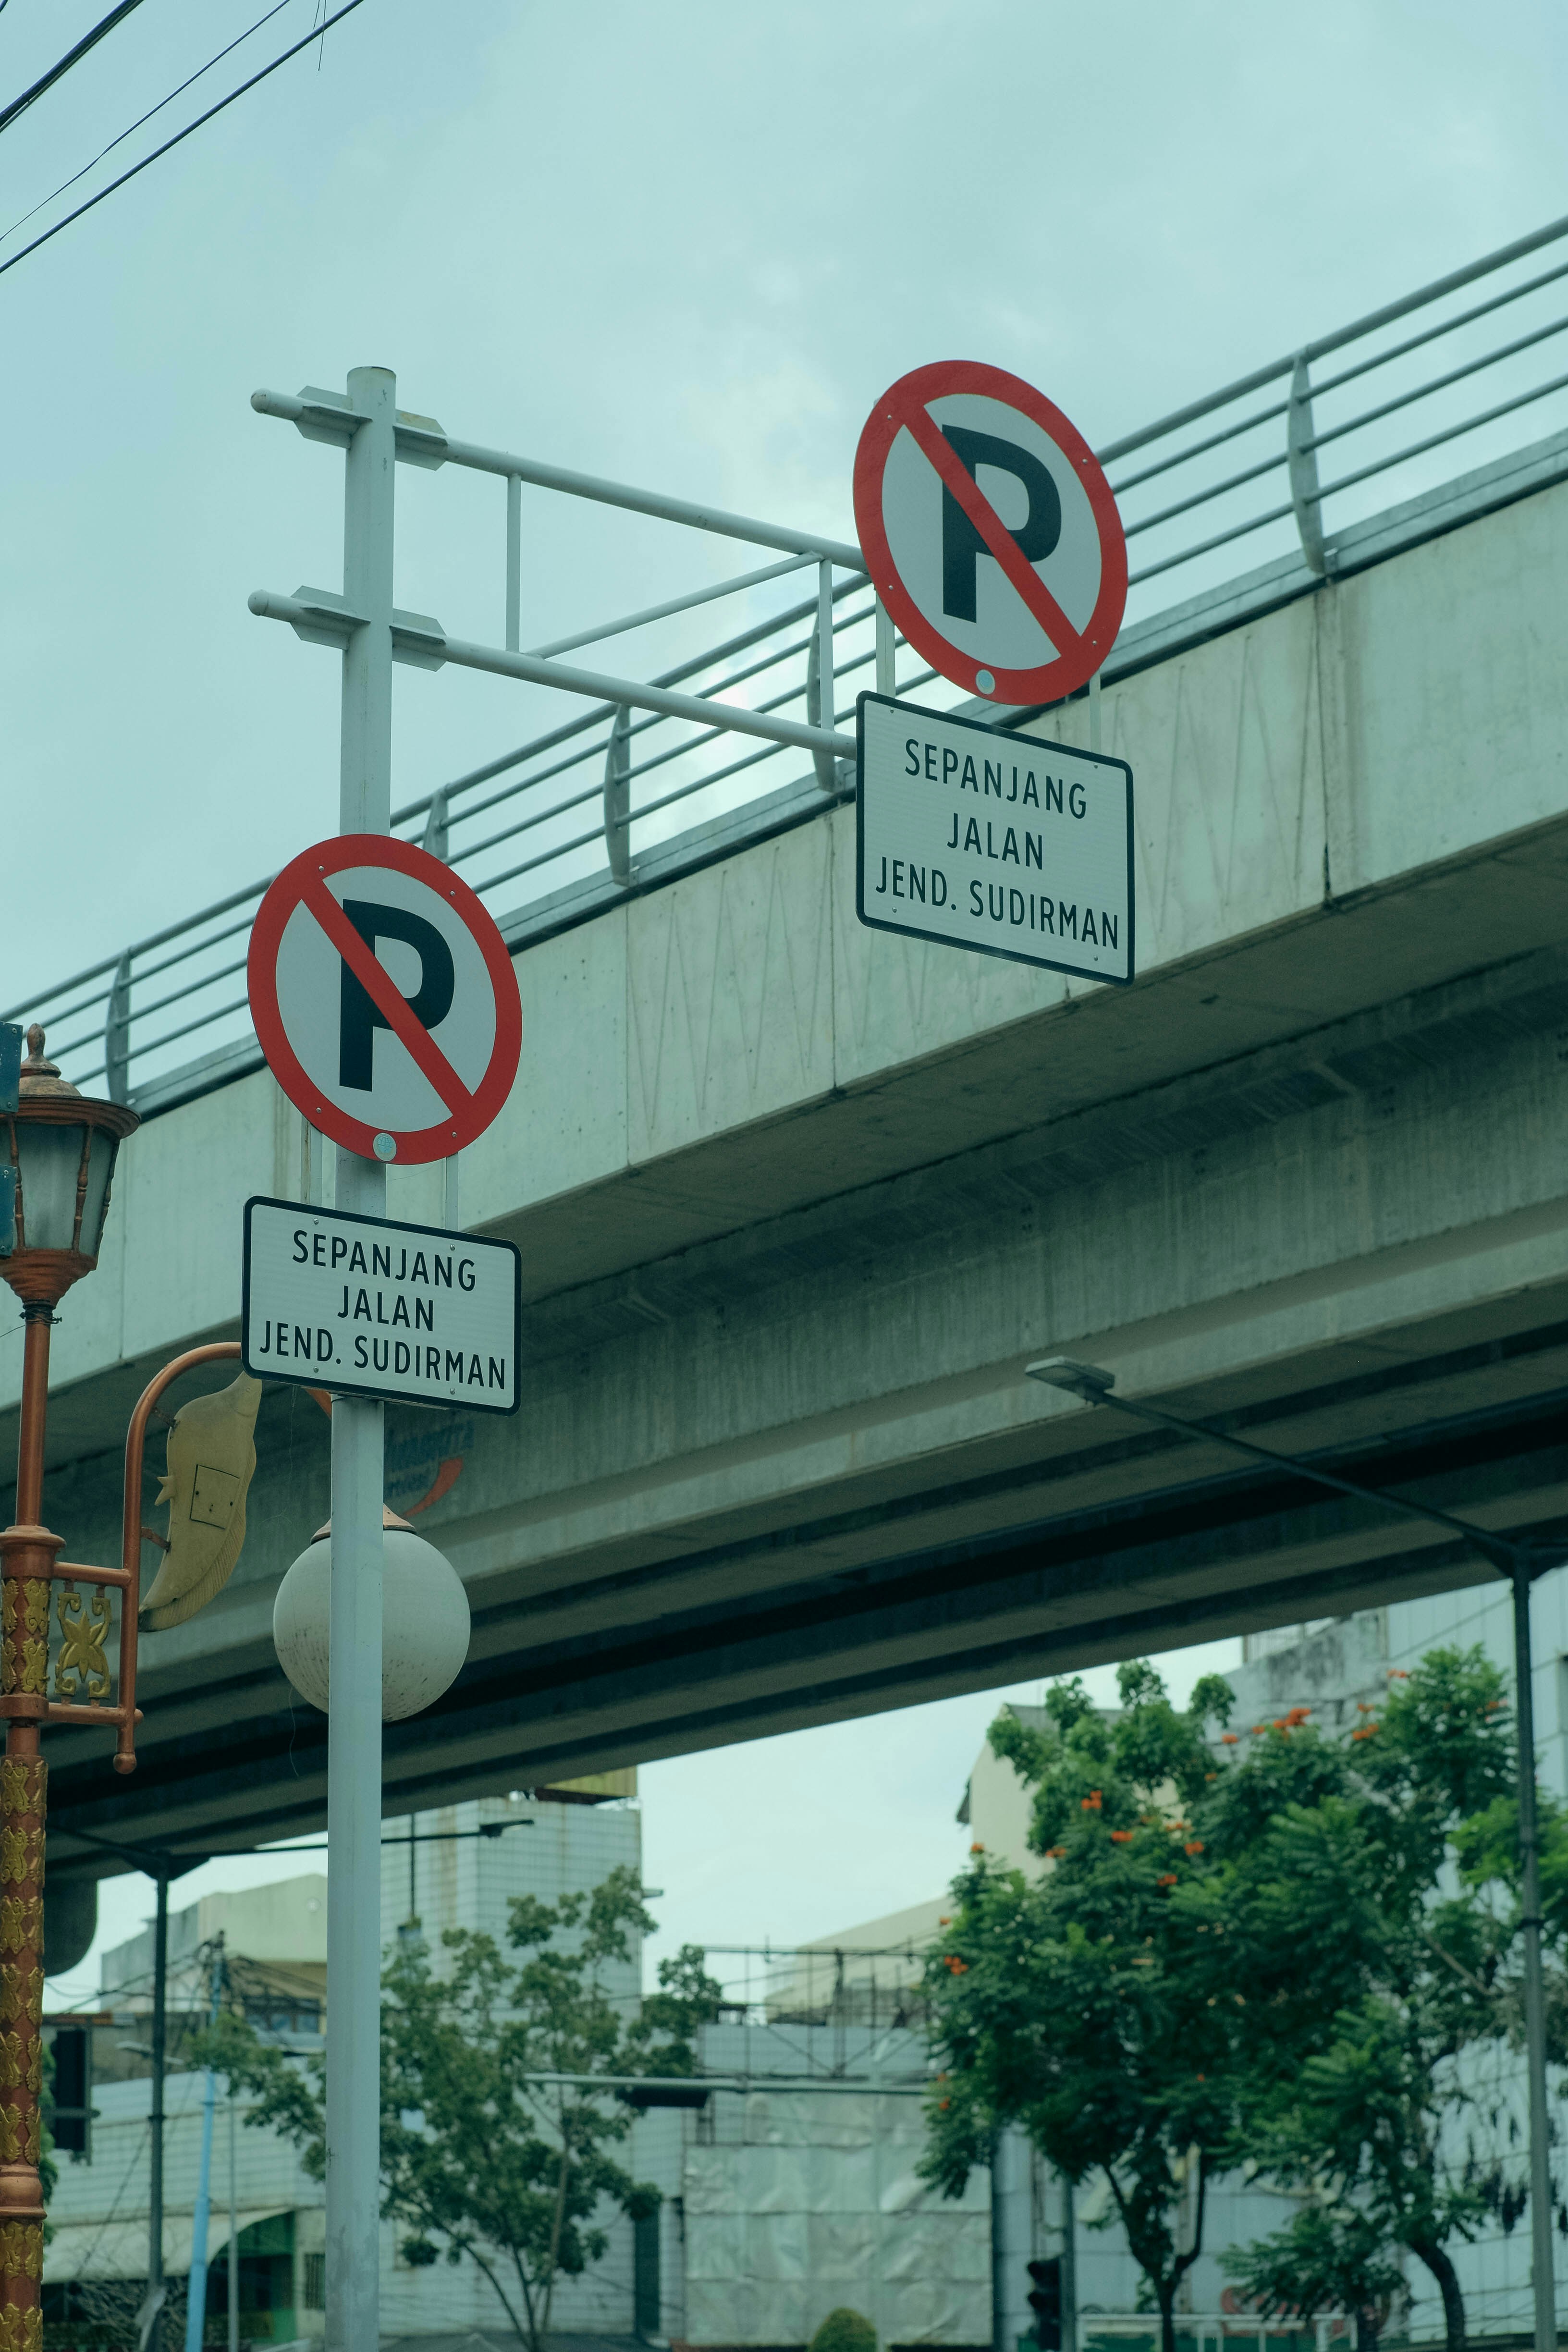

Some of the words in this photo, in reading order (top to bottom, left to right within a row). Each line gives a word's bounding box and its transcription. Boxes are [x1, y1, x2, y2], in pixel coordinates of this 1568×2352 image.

[942, 424, 1062, 624] P
[905, 738, 1087, 820] SEPANJANG
[946, 812, 1043, 870] JALAN
[875, 856, 957, 911] JEND.
[969, 880, 1118, 950] SUDIRMAN
[339, 898, 455, 1092] P
[292, 1229, 476, 1292] SEPANJANG
[337, 1285, 434, 1332] JALAN
[259, 1320, 342, 1365] JEND.
[354, 1335, 505, 1390] SUDIRMAN
